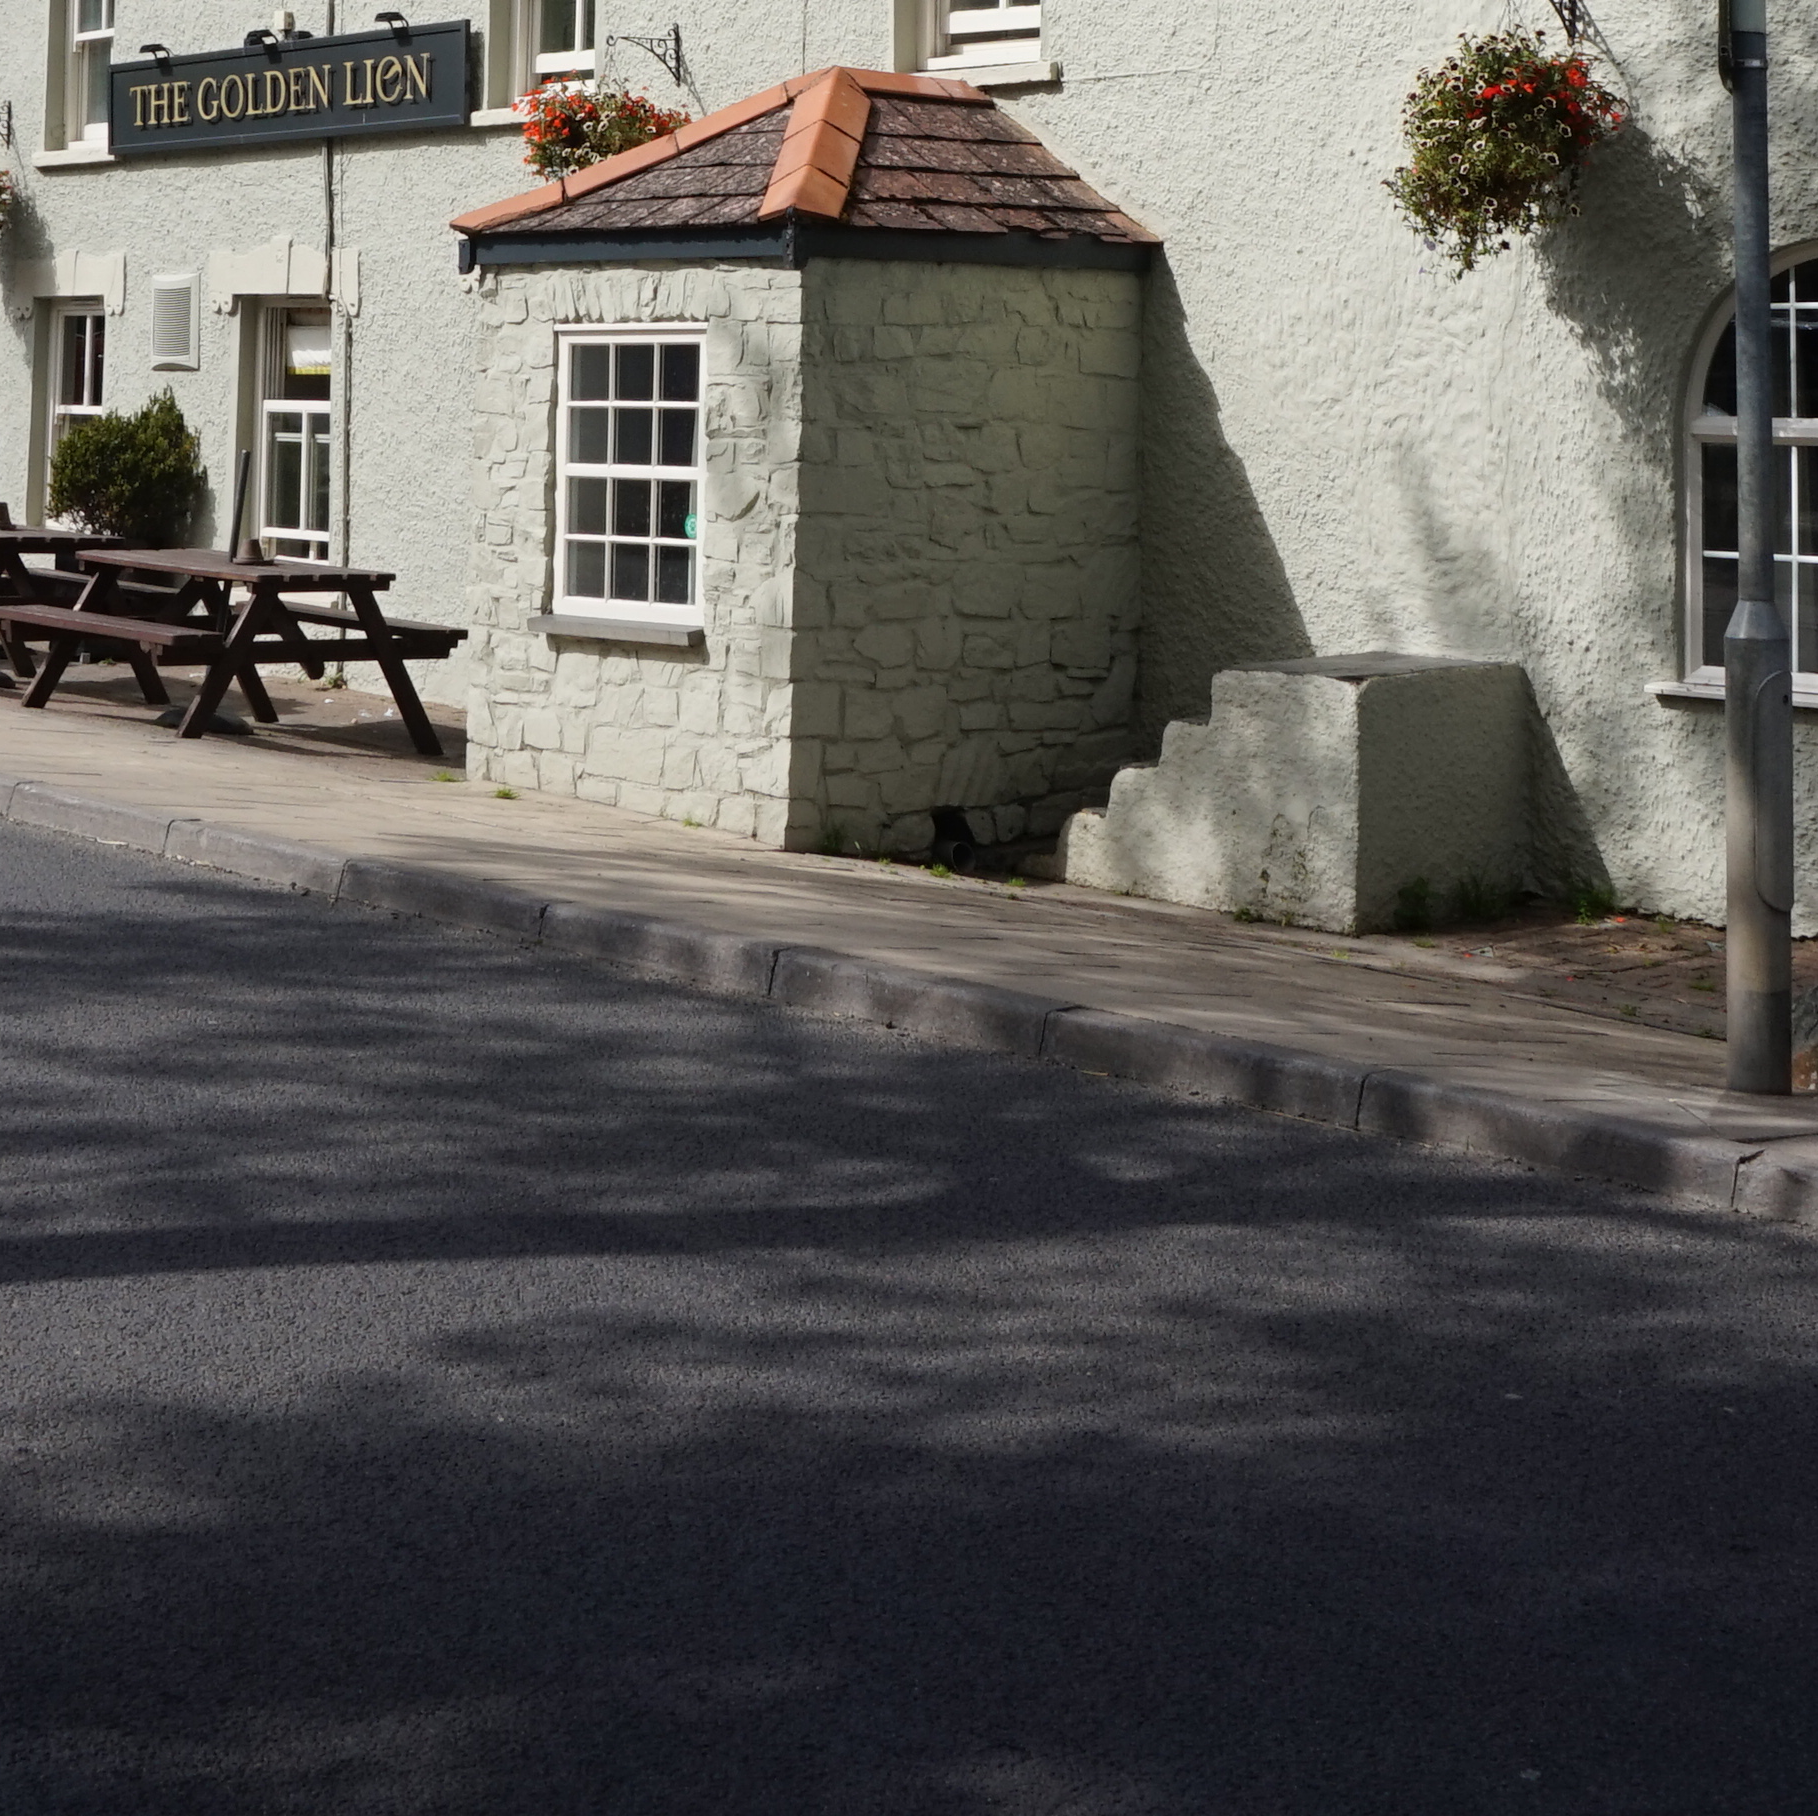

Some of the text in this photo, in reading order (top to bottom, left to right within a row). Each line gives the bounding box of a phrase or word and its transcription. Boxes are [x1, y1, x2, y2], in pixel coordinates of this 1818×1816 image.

[129, 52, 430, 126] THE GOLDEN LION
